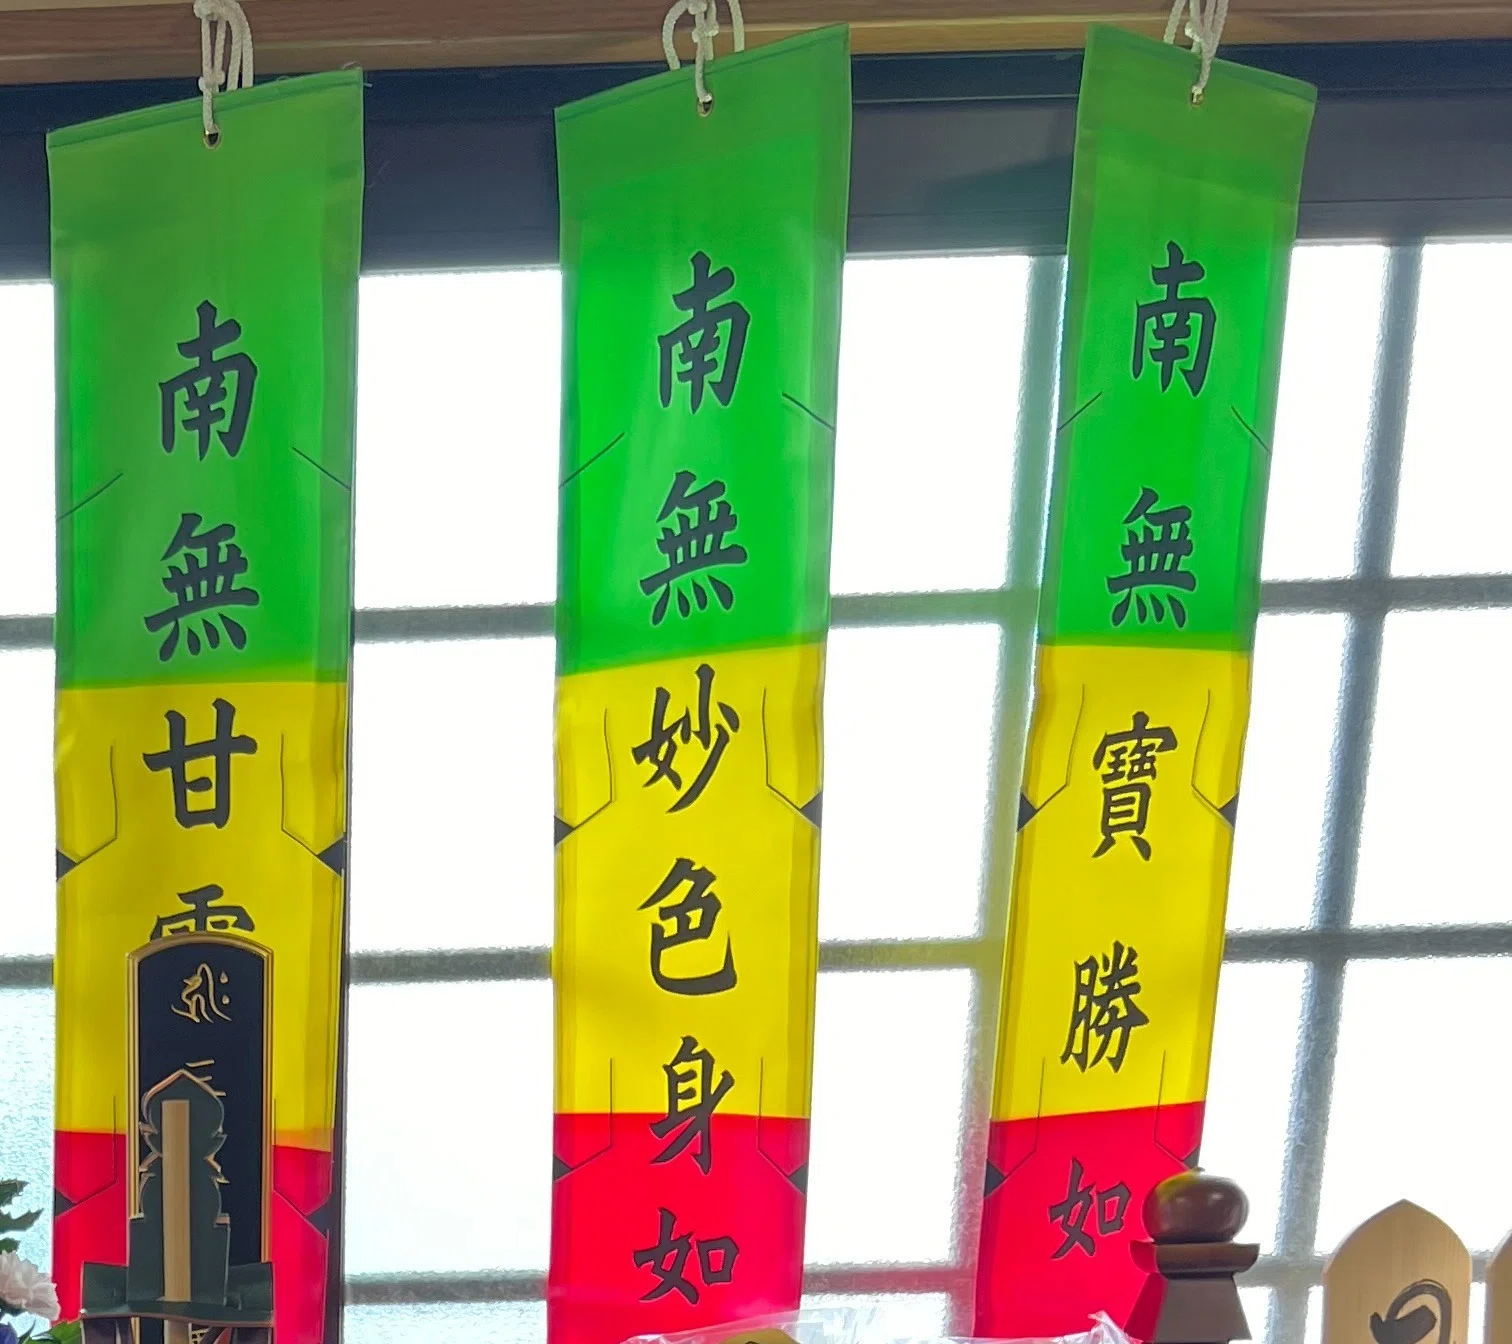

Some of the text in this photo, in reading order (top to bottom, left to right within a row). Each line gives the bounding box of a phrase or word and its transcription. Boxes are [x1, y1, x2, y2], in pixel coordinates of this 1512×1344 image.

[632, 252, 752, 1304] 南無妙色身如
[1047, 241, 1216, 1262] 南無寶勝如
